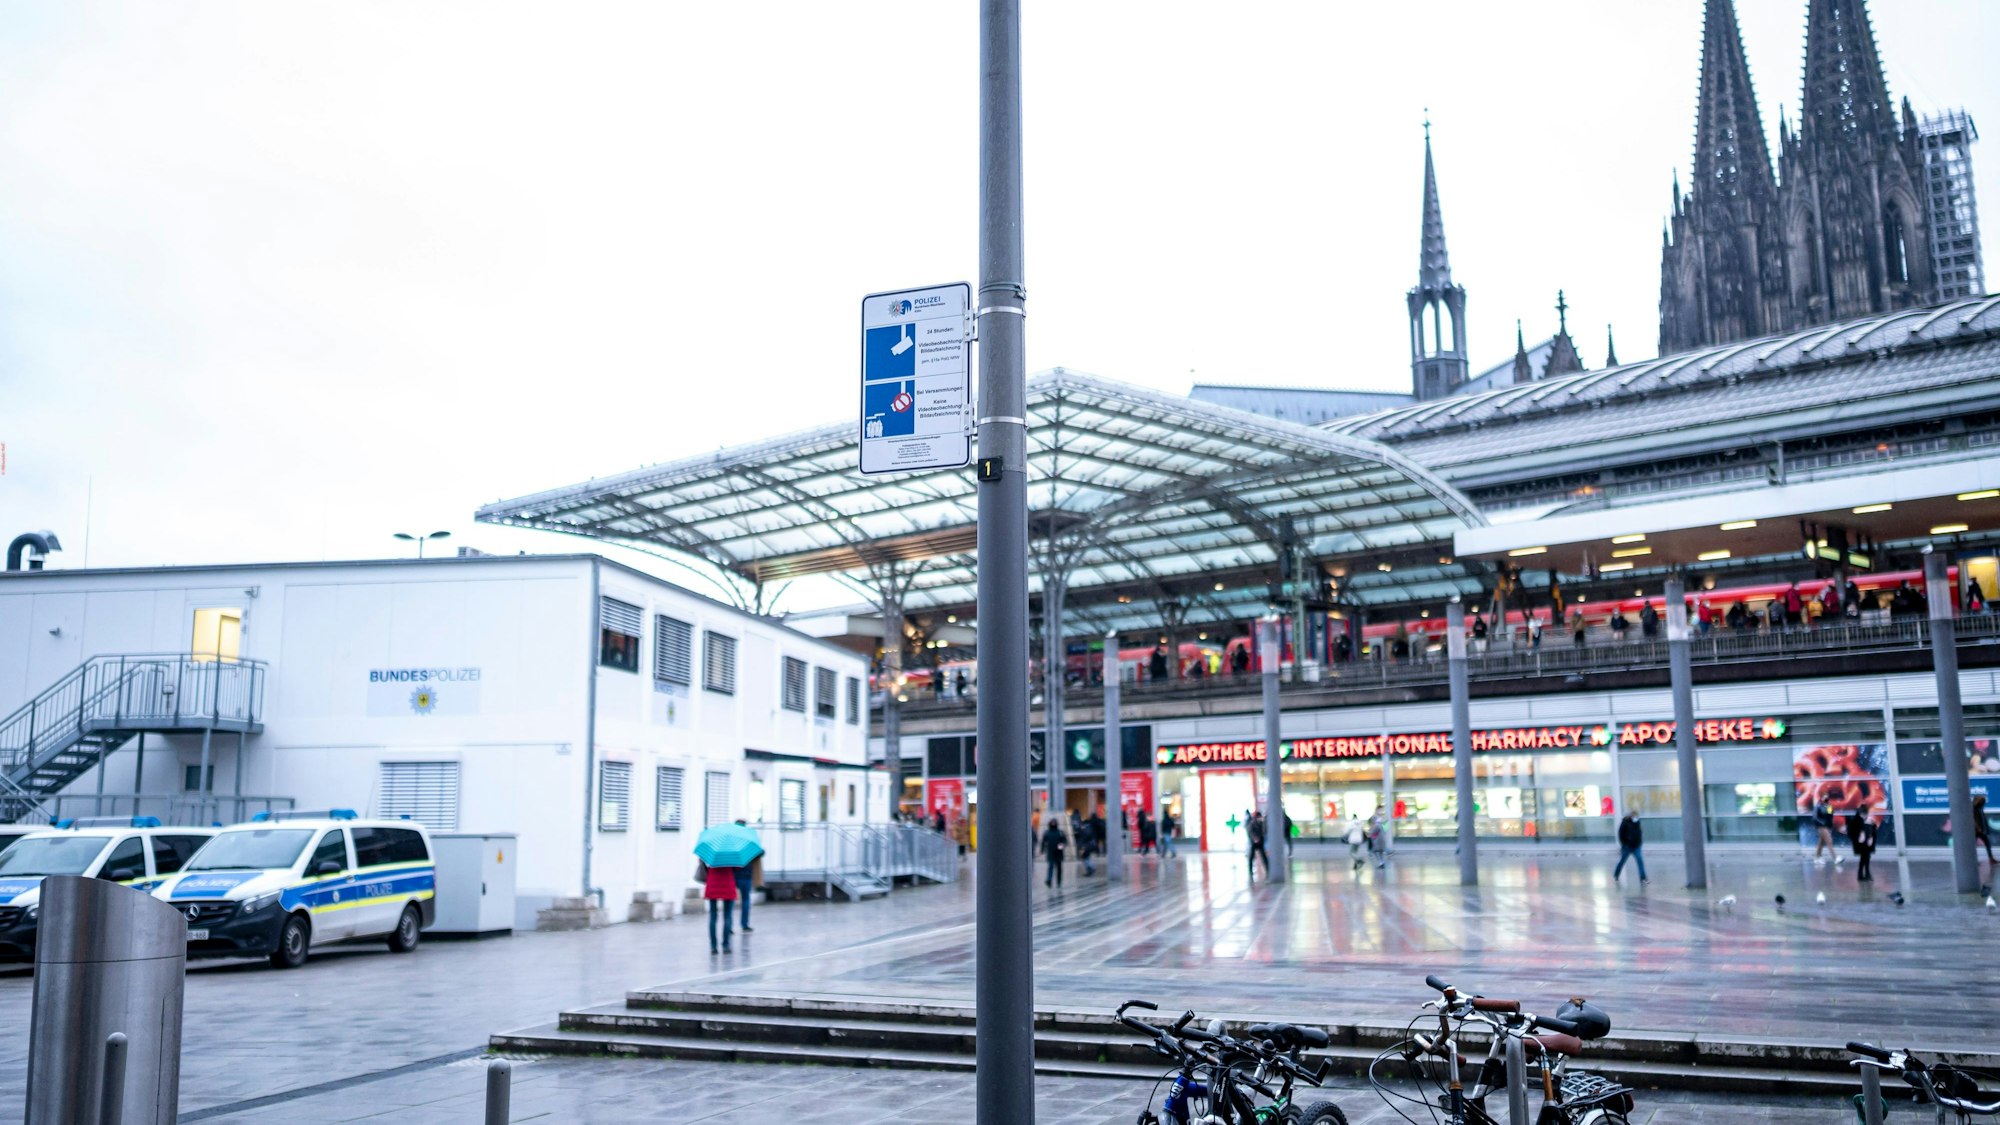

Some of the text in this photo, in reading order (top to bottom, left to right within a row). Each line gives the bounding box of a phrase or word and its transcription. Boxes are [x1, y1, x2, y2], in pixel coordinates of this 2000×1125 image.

[914, 296, 941, 305] POLIZEI
[920, 345, 961, 354] Bildaufzeichnung
[919, 410, 961, 419] Bildaufzeichnung
[985, 460, 991, 476] 1
[369, 669, 481, 683] BUNDESPOLIZEI
[1174, 726, 1584, 764] APOTHEKE INTERNATIONAL HARMACY
[365, 882, 393, 897] POLIZEI
